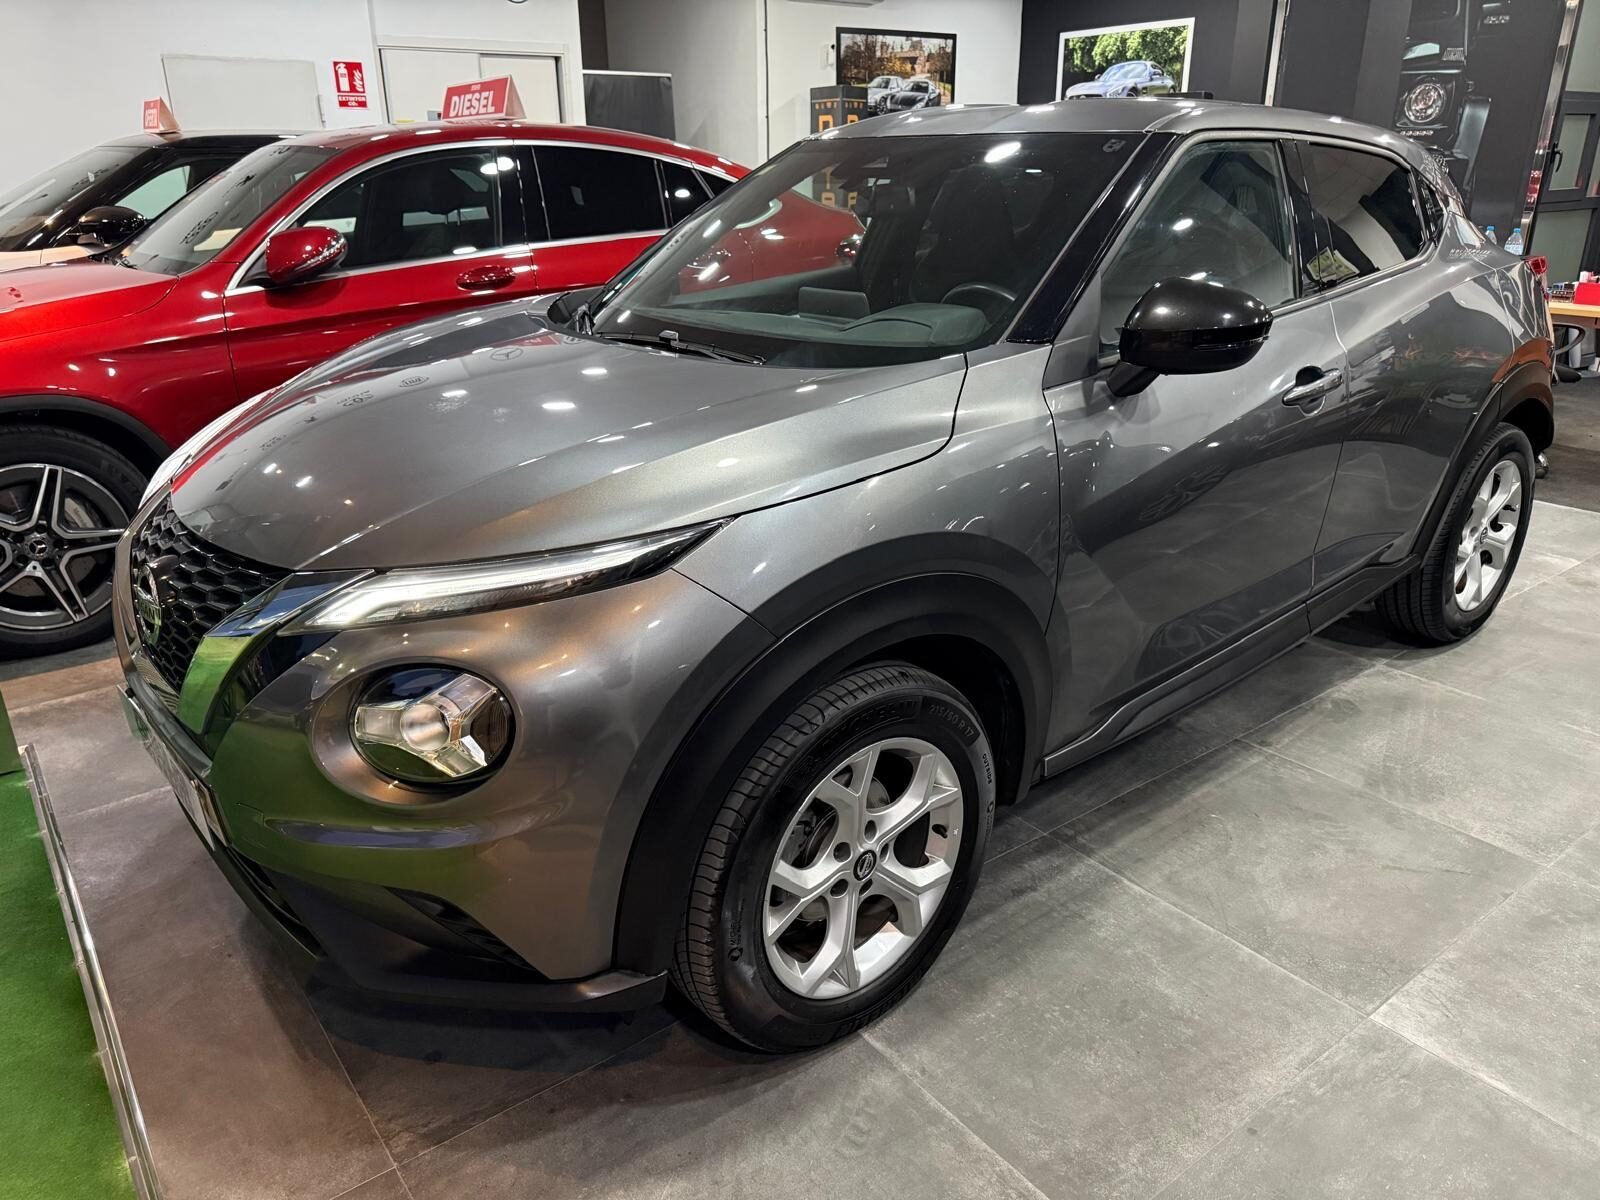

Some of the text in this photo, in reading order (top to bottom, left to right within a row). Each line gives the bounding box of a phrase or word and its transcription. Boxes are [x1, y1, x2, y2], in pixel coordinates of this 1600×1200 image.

[449, 90, 495, 117] DIESEL
[964, 726, 975, 737] 17
[982, 752, 992, 784] OUTSIDE
